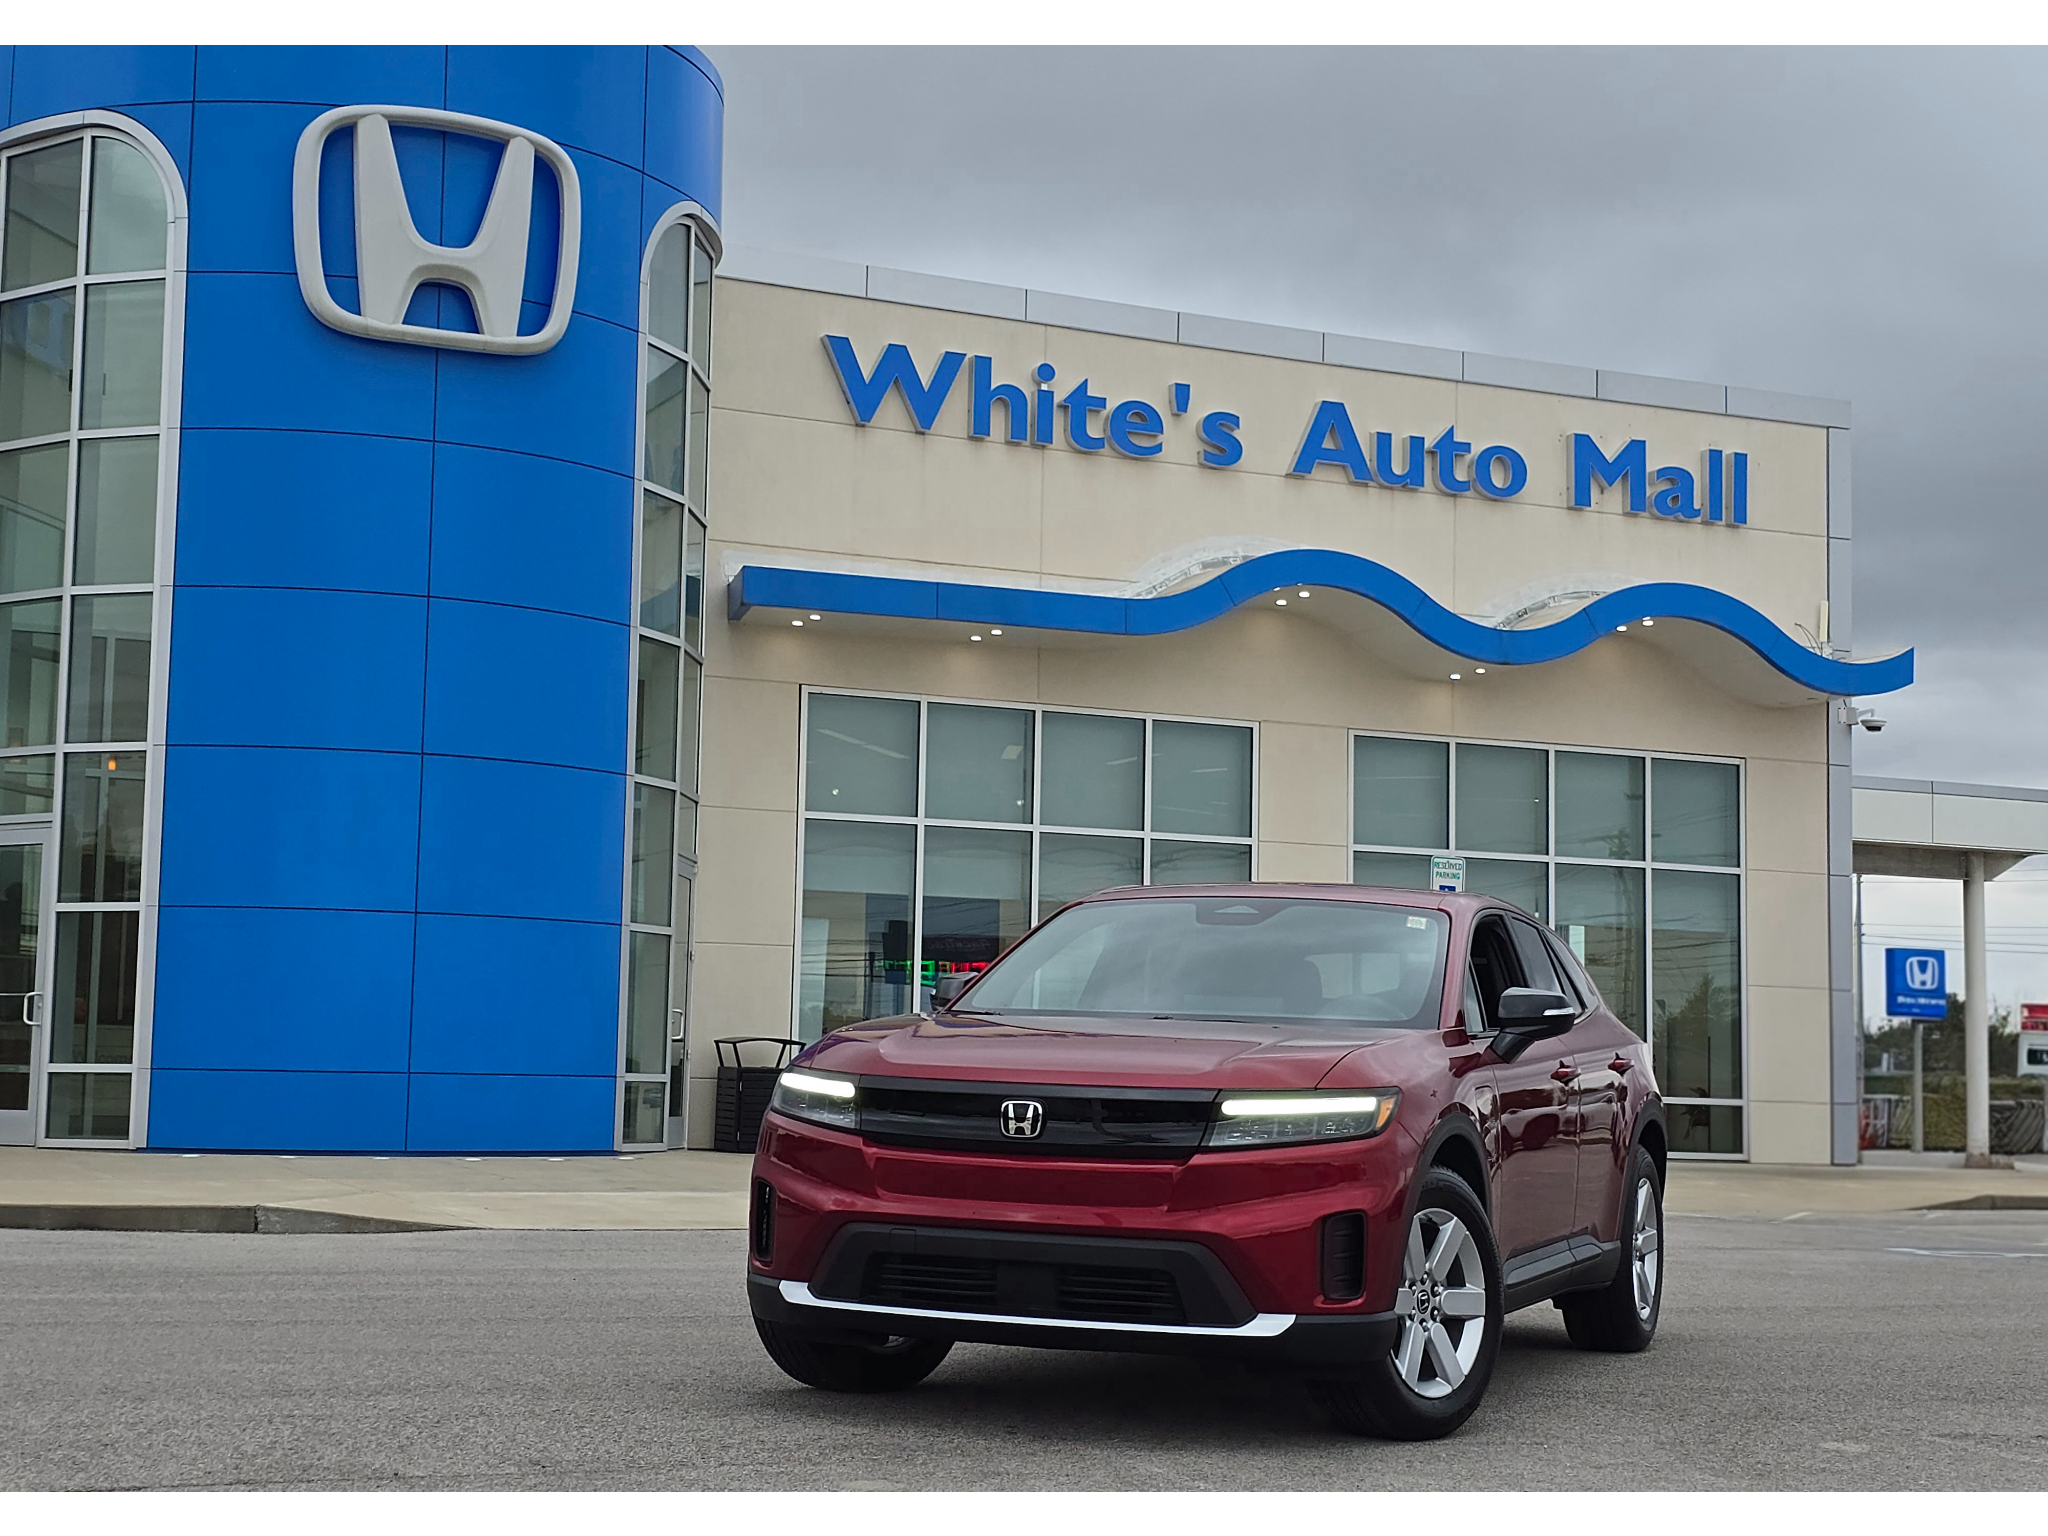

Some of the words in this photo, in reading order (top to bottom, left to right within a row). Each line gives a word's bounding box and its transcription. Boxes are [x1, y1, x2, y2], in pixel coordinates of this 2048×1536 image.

[820, 334, 1244, 469] White's
[1285, 400, 1528, 501] Auto
[1566, 432, 1749, 527] Mall
[1434, 861, 1462, 871] RESERVED
[1435, 871, 1460, 880] PARKING
